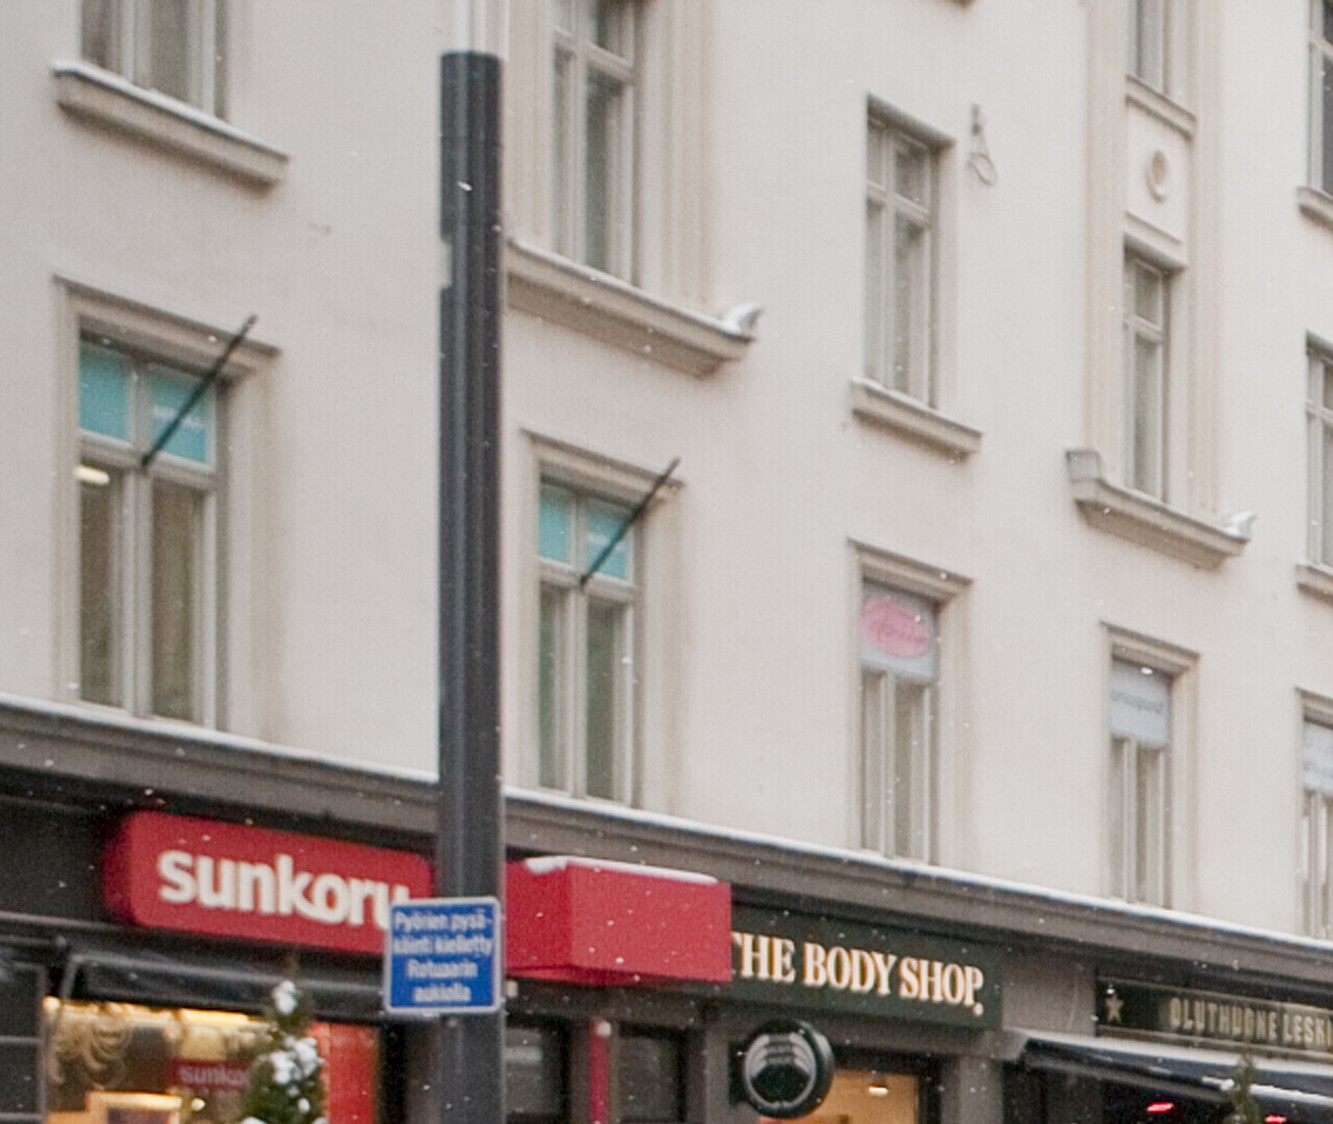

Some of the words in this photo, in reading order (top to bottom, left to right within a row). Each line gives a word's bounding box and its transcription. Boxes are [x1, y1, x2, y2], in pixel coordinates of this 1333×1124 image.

[407, 959, 478, 978] Rotuaarin
[803, 942, 898, 996] BODY
[899, 956, 985, 1008] SHOP
[414, 983, 471, 1002] aukiolla
[1168, 997, 1277, 1041] OLUTHUONE
